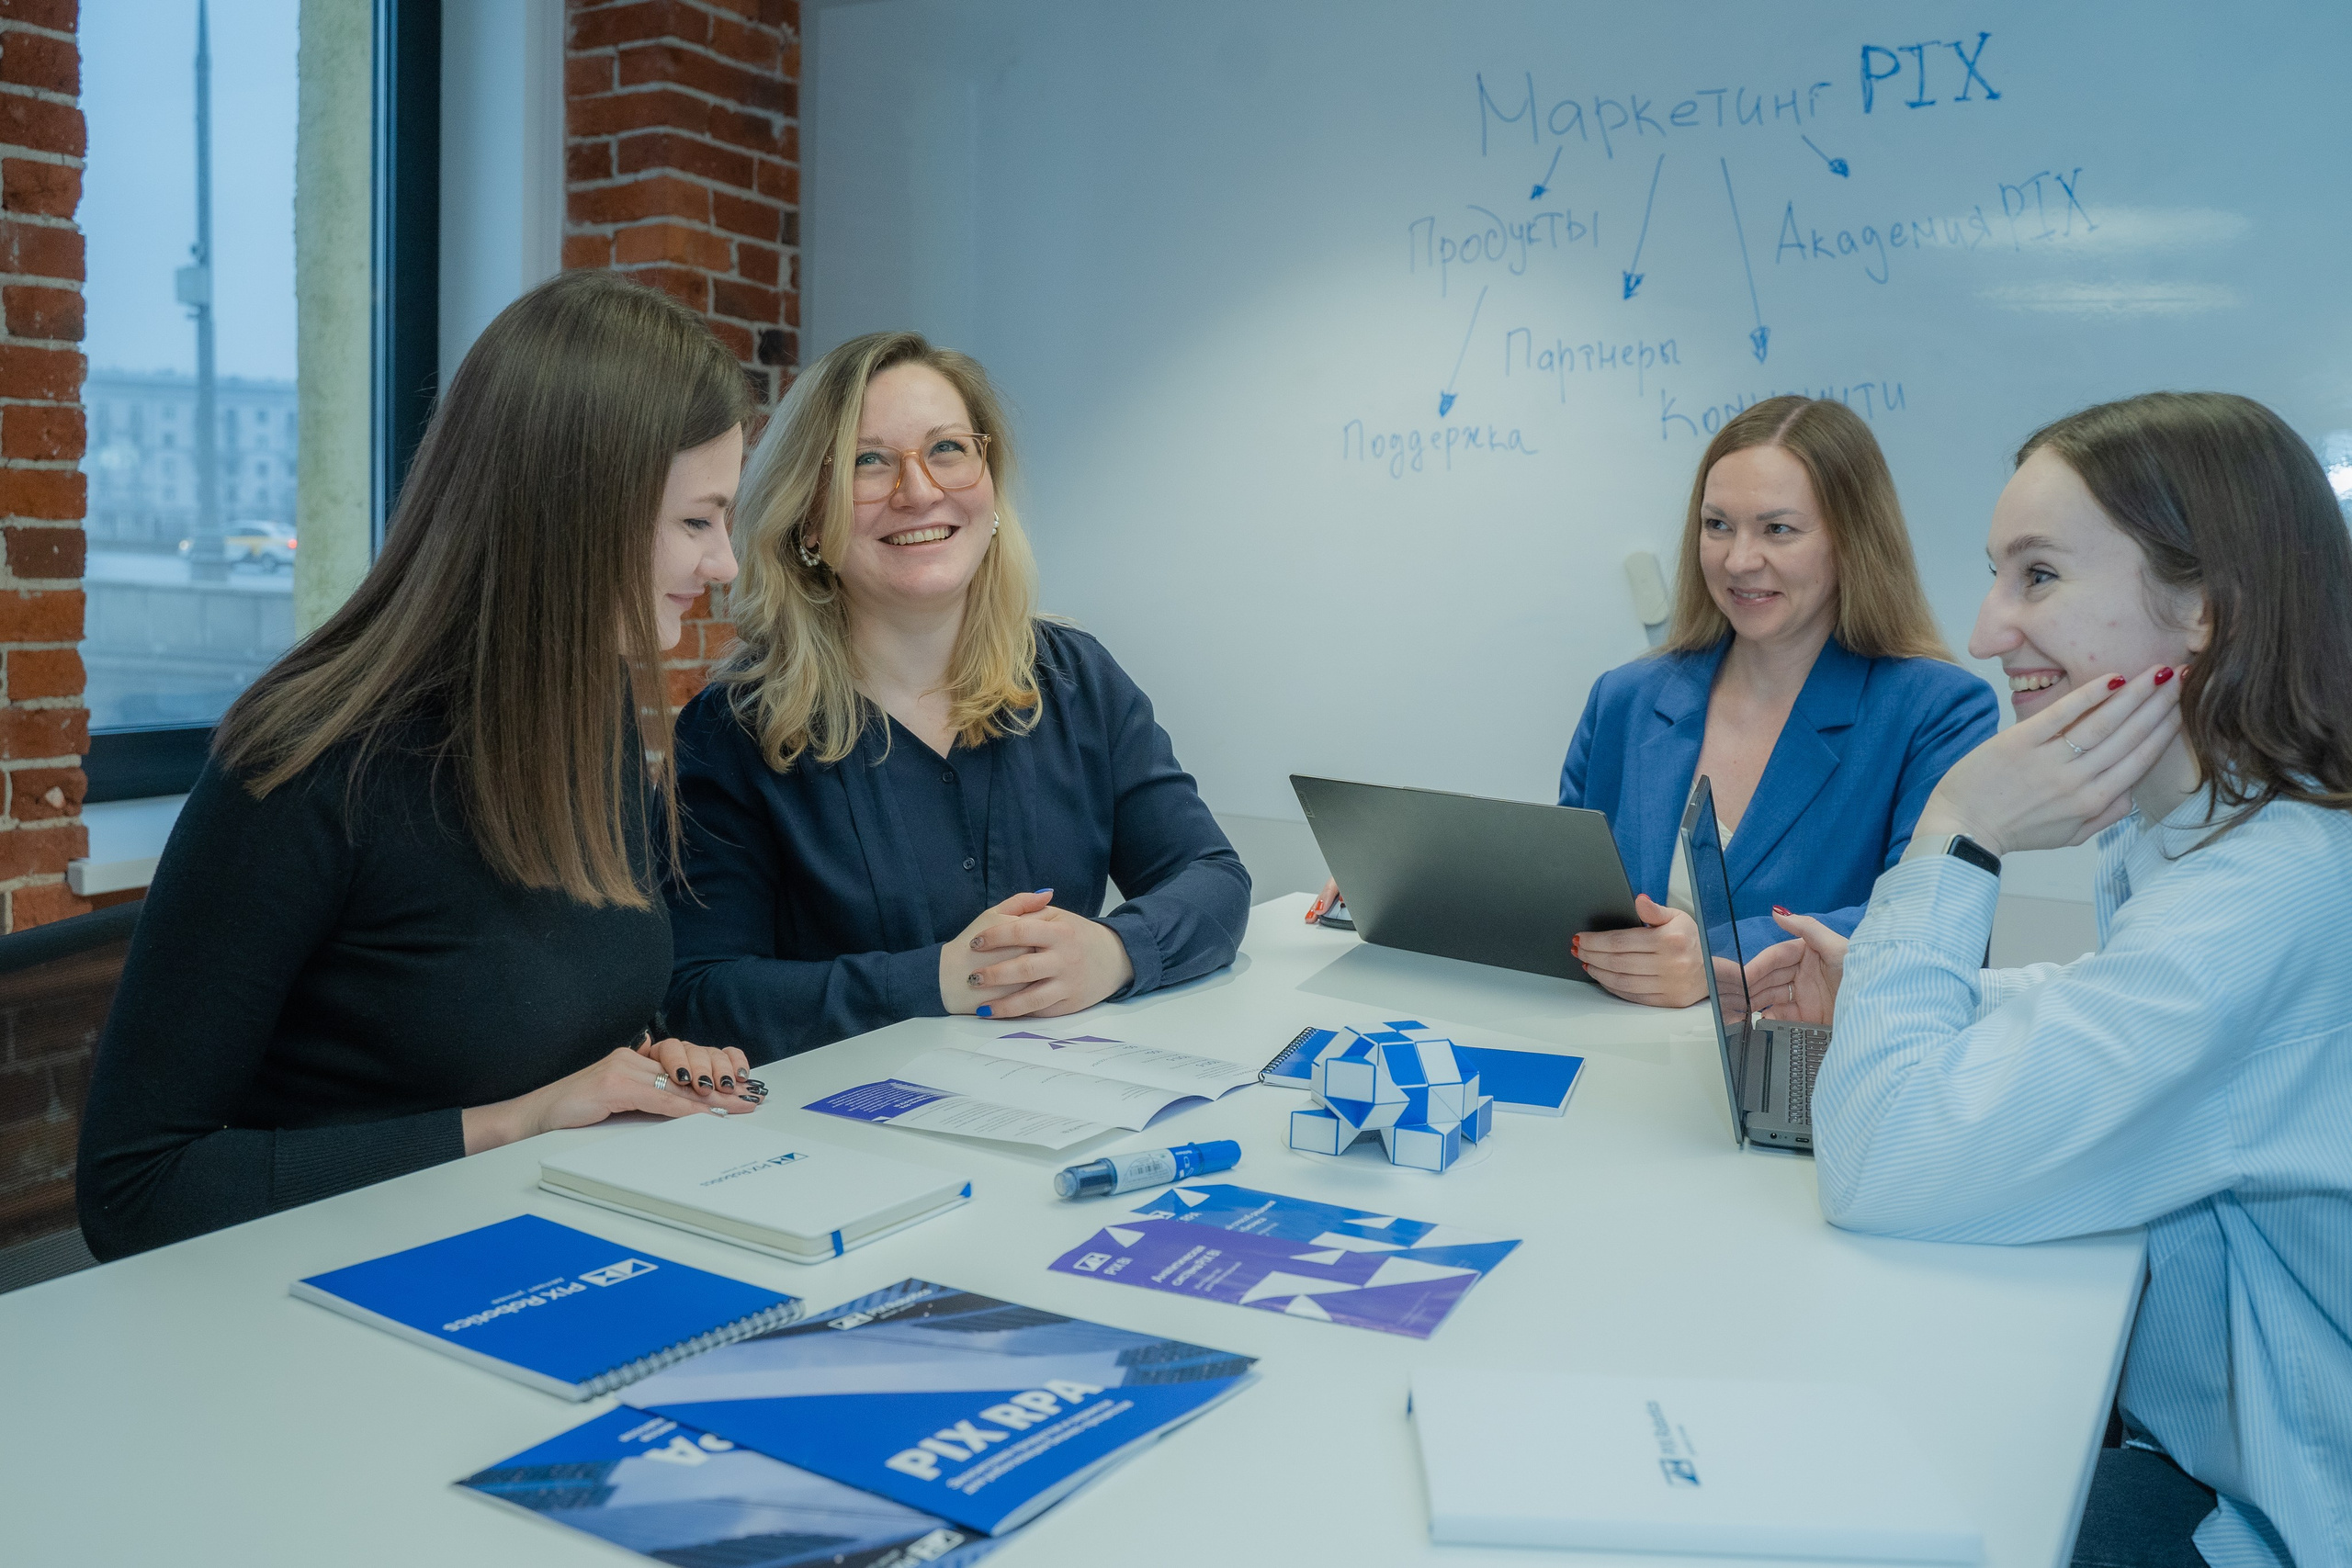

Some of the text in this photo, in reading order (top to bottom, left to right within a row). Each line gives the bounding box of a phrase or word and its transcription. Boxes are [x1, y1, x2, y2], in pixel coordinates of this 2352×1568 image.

[1476, 31, 2002, 159] Маркетинг PIX
[1408, 204, 1599, 299] Продукты
[1775, 167, 2098, 285] Академия PIX
[1343, 419, 1540, 479] Поддержка
[442, 1294, 548, 1332] Robotics
[539, 1281, 588, 1301] PIX
[884, 1418, 1011, 1482] PIX
[978, 1378, 1105, 1432] RPA
